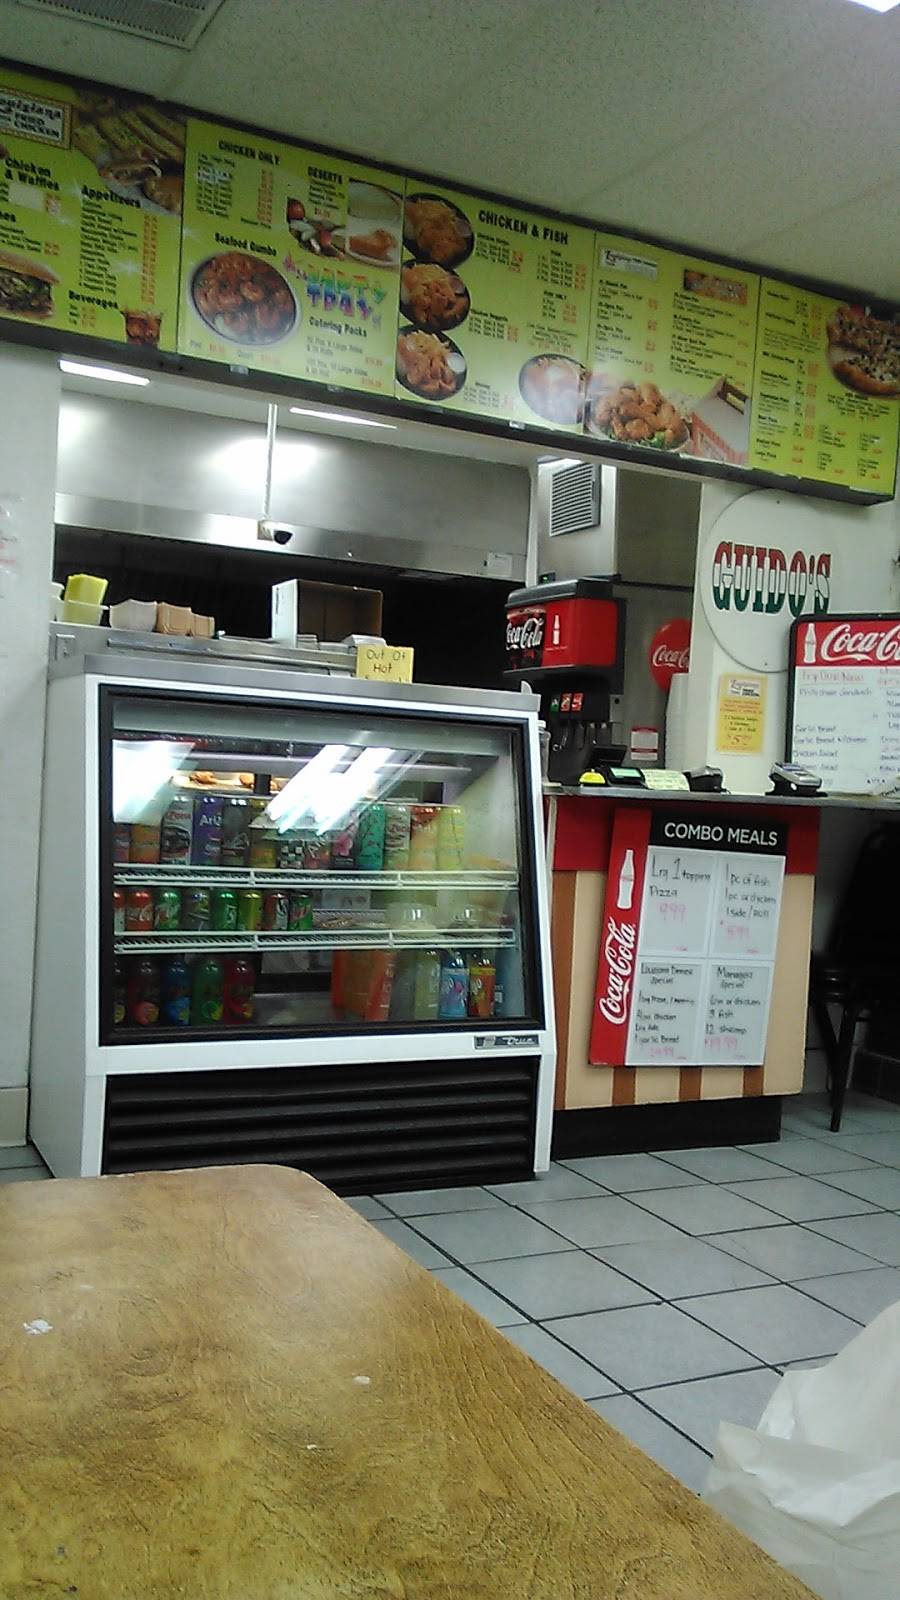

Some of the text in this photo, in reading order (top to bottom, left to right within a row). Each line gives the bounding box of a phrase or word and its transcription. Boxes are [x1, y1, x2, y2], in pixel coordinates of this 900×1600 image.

[218, 140, 280, 165] CHICKEN ONLY
[5, 158, 51, 177] Chicken
[18, 171, 60, 191] Waffles
[81, 185, 141, 208] Appetizers
[478, 210, 569, 245] CHICKEN & FISH
[214, 232, 248, 250] Seafood
[68, 290, 119, 309] Beverages
[309, 316, 367, 337] Catering Packs
[712, 540, 832, 618] GUIDO'S
[366, 649, 384, 660] Out
[373, 663, 392, 673] Hot
[664, 822, 778, 847] COMBO MEALS
[649, 885, 679, 898] Pizza
[599, 916, 636, 1025] Coca-Cola
